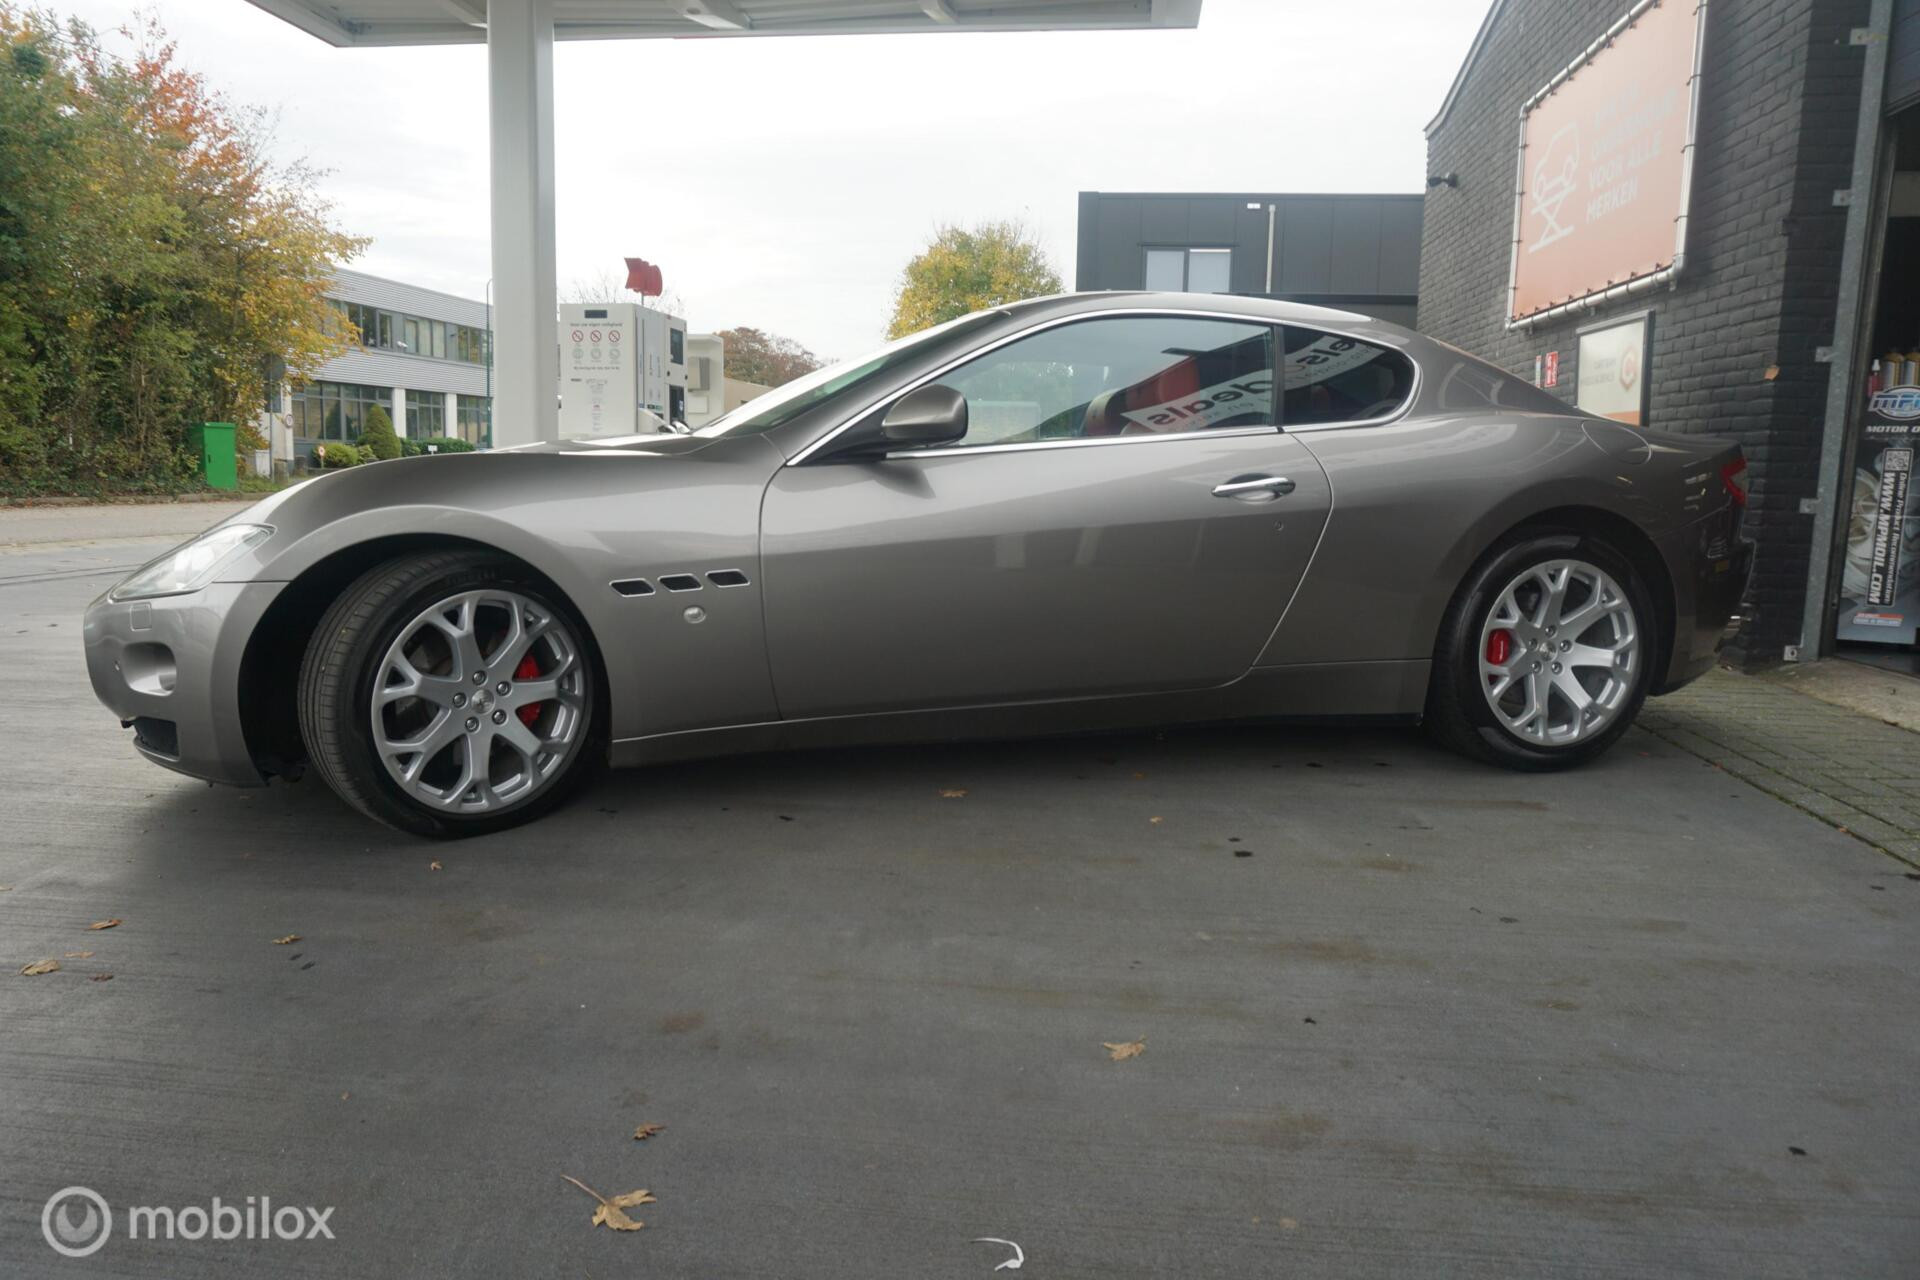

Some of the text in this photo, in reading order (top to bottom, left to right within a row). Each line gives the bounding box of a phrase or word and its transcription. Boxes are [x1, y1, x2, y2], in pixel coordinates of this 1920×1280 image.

[1586, 176, 1639, 224] MERKEN
[1865, 425, 1909, 433] MOTOR
[1869, 472, 1896, 604] WWW.MPMOIL.COM
